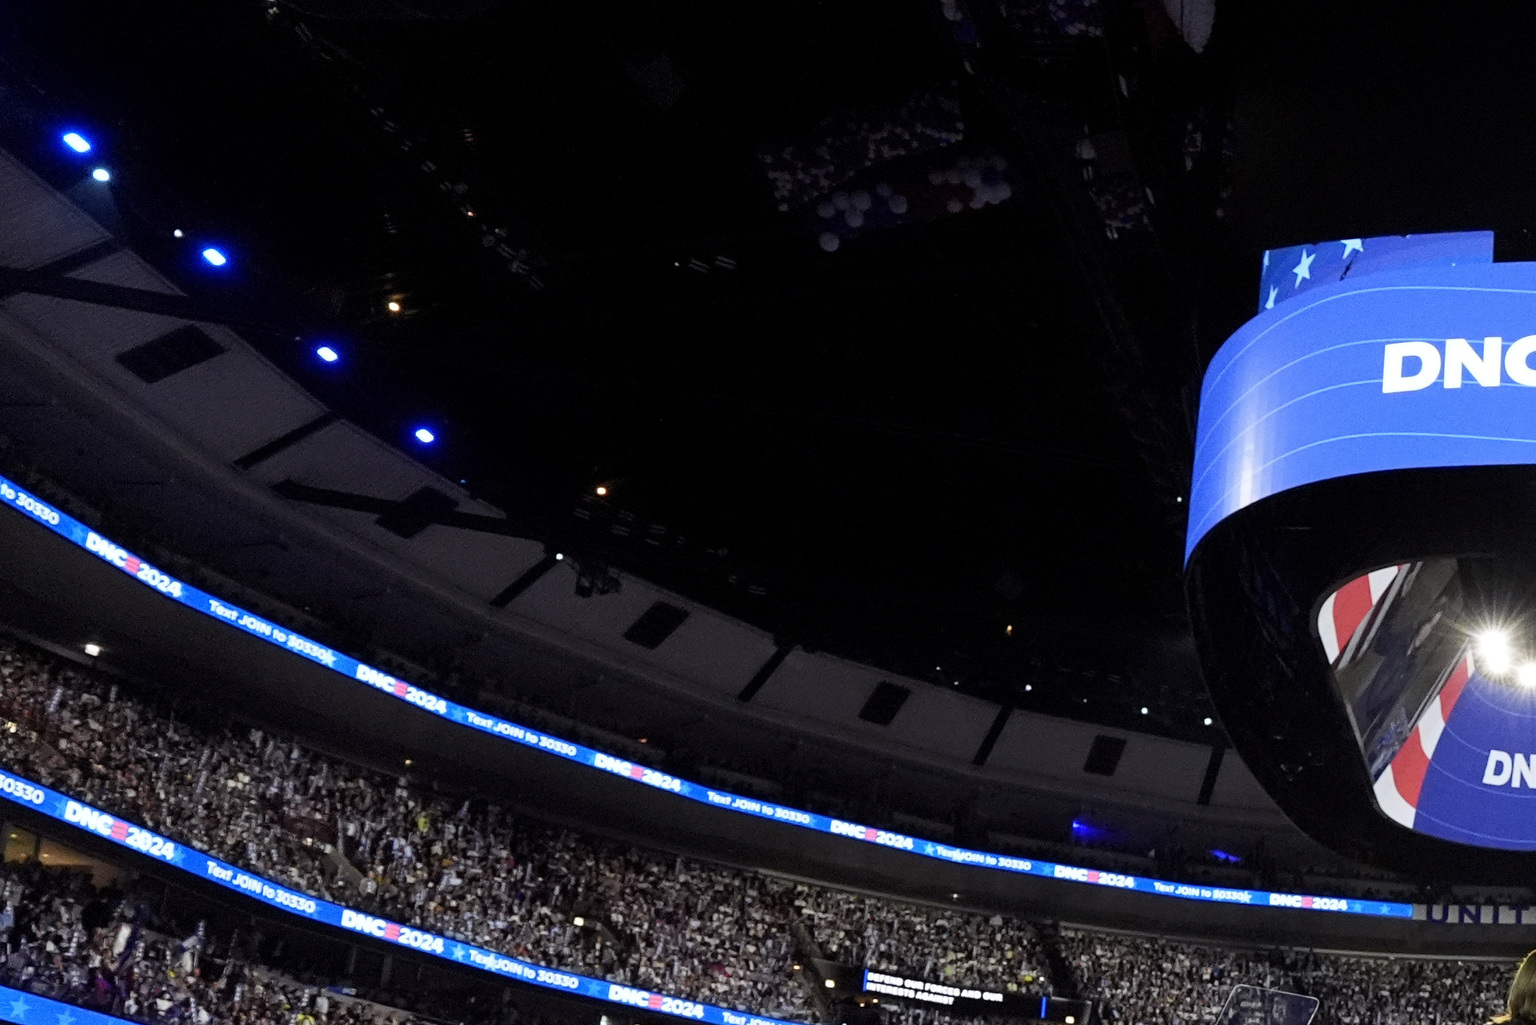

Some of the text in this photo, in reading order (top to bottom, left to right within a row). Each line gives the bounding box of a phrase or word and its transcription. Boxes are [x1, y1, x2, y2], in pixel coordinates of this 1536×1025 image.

[16, 493, 59, 524] 30330
[86, 532, 182, 597] DNC 2024
[209, 600, 325, 659] Text JOIN to 30330
[356, 664, 447, 714] DNC 2024
[467, 712, 576, 756] Text JOIN to 30330
[595, 753, 681, 791] DNC 2024
[64, 801, 175, 861] DNC 2024
[830, 820, 913, 850] DNC 2024
[207, 861, 316, 914] Text JOIN to 30330
[1054, 865, 1134, 888] DNC 2024
[1269, 893, 1347, 911] DNC 2024
[341, 909, 444, 954] DNC 2024
[608, 984, 704, 1019] DNC 2024
[723, 1011, 746, 1025] Text
